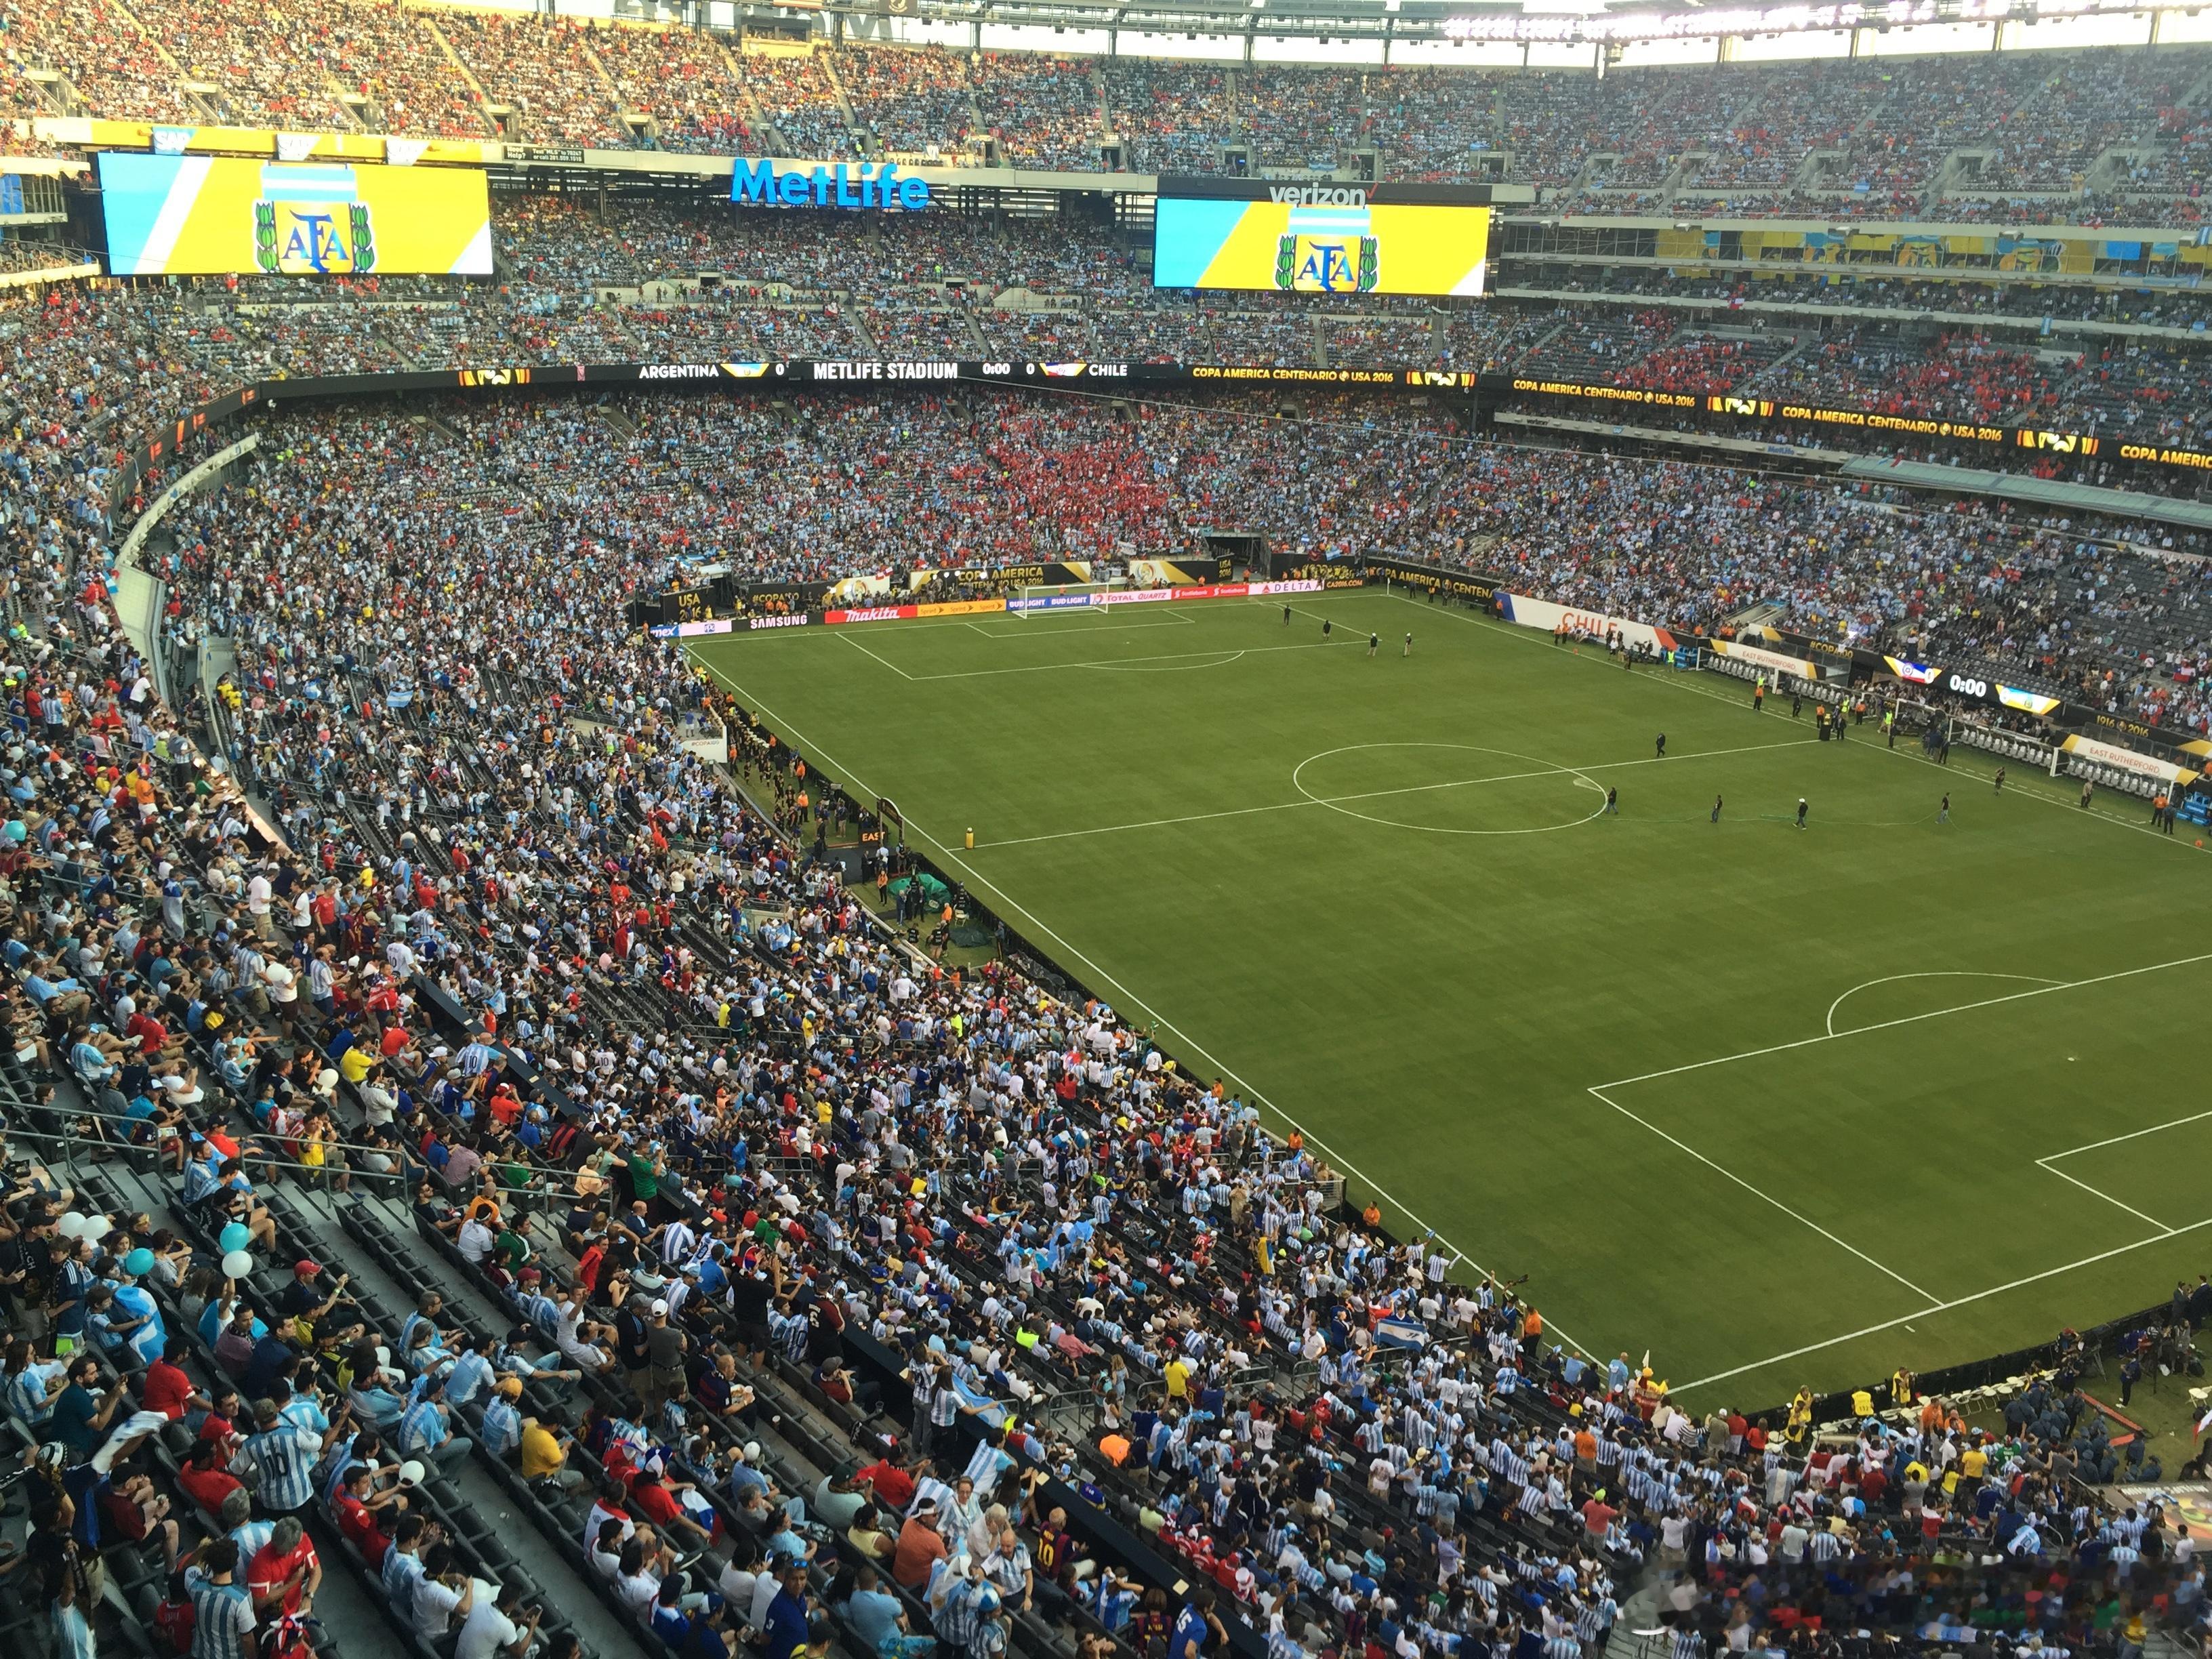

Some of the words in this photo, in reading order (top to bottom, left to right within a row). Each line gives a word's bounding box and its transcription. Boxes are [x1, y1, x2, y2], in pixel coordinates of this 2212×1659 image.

[731, 157, 930, 209] MetLife
[1269, 182, 1366, 206] verizon
[639, 365, 719, 379] ARGENTINA
[775, 363, 785, 375] 0
[814, 363, 882, 380] METLIFE
[887, 363, 958, 380] STADIUM
[983, 363, 1010, 375] 0:00
[1026, 363, 1035, 374] 0
[1088, 364, 1128, 377] CHILE
[1193, 367, 1221, 377] COPA
[1223, 369, 1270, 379] AMERICA
[1273, 369, 1336, 381] CENTENARIO
[1351, 372, 1370, 382] USA
[1372, 373, 1393, 382] 2016
[1513, 380, 1538, 391] COPA
[1540, 382, 1582, 396] AMERICA
[1584, 387, 1642, 402] CENTENARIO
[1656, 394, 1673, 405] USA
[1675, 396, 1695, 407] 2016
[1782, 406, 1811, 419] COPA
[1814, 410, 1864, 426] AMERICA
[1868, 415, 1937, 434] CENTENARIO
[1952, 425, 1975, 438] USA
[1978, 428, 2003, 441] 2016
[2121, 445, 2157, 462] COPA
[1220, 559, 1231, 569] USA
[958, 571, 988, 581] COP
[992, 567, 1044, 581] AMERICA
[1399, 571, 1441, 588] AMERICA
[1275, 582, 1311, 592] DELTA
[679, 592, 701, 608] USA
[1009, 599, 1024, 608] BUD
[1051, 596, 1067, 605] BUD
[1067, 595, 1088, 605] LIGHT
[679, 606, 701, 621] 216
[750, 615, 807, 630] SAMSUNG
[1742, 651, 1757, 660] EAST
[1950, 674, 1986, 697] 0:00
[2097, 715, 2115, 728] 1916
[2127, 724, 2149, 737] 2016
[2089, 747, 2108, 758] EAST
[862, 831, 886, 842] EAST
[469, 1055, 478, 1069] 10
[601, 1057, 609, 1067] 10
[780, 1136, 790, 1146] 18
[1504, 1374, 1516, 1385] 10
[2020, 1534, 2032, 1548] 10
[1038, 1536, 1054, 1567] 10
